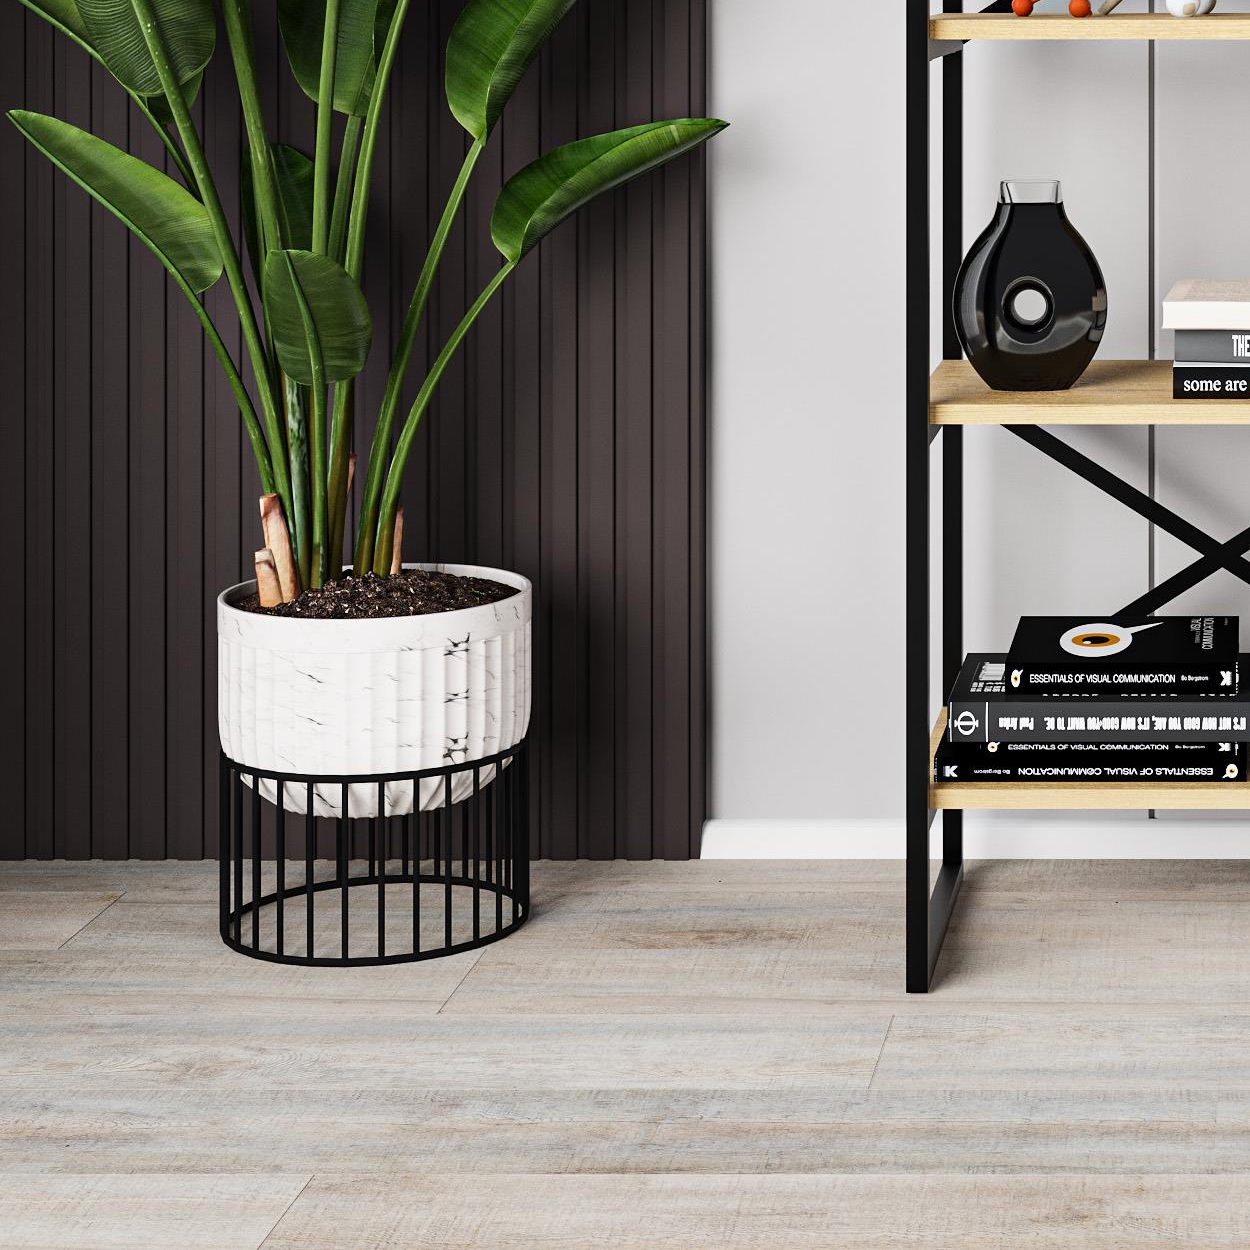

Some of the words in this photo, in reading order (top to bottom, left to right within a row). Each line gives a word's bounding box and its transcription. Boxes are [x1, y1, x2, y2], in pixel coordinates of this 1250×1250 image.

[1232, 335, 1250, 357] THE
[1183, 380, 1221, 392] some
[1225, 380, 1247, 392] are
[1029, 673, 1073, 683] ESSENTIALS
[1074, 673, 1084, 683] OF
[1085, 673, 1111, 683] VISUAL
[1113, 673, 1175, 683] COMMUNICATION
[1018, 767, 1102, 775] COMMUNICATION
[1104, 767, 1139, 775] VISUAL
[1140, 767, 1153, 775] OF
[1155, 767, 1213, 775] ESSENTIALS
